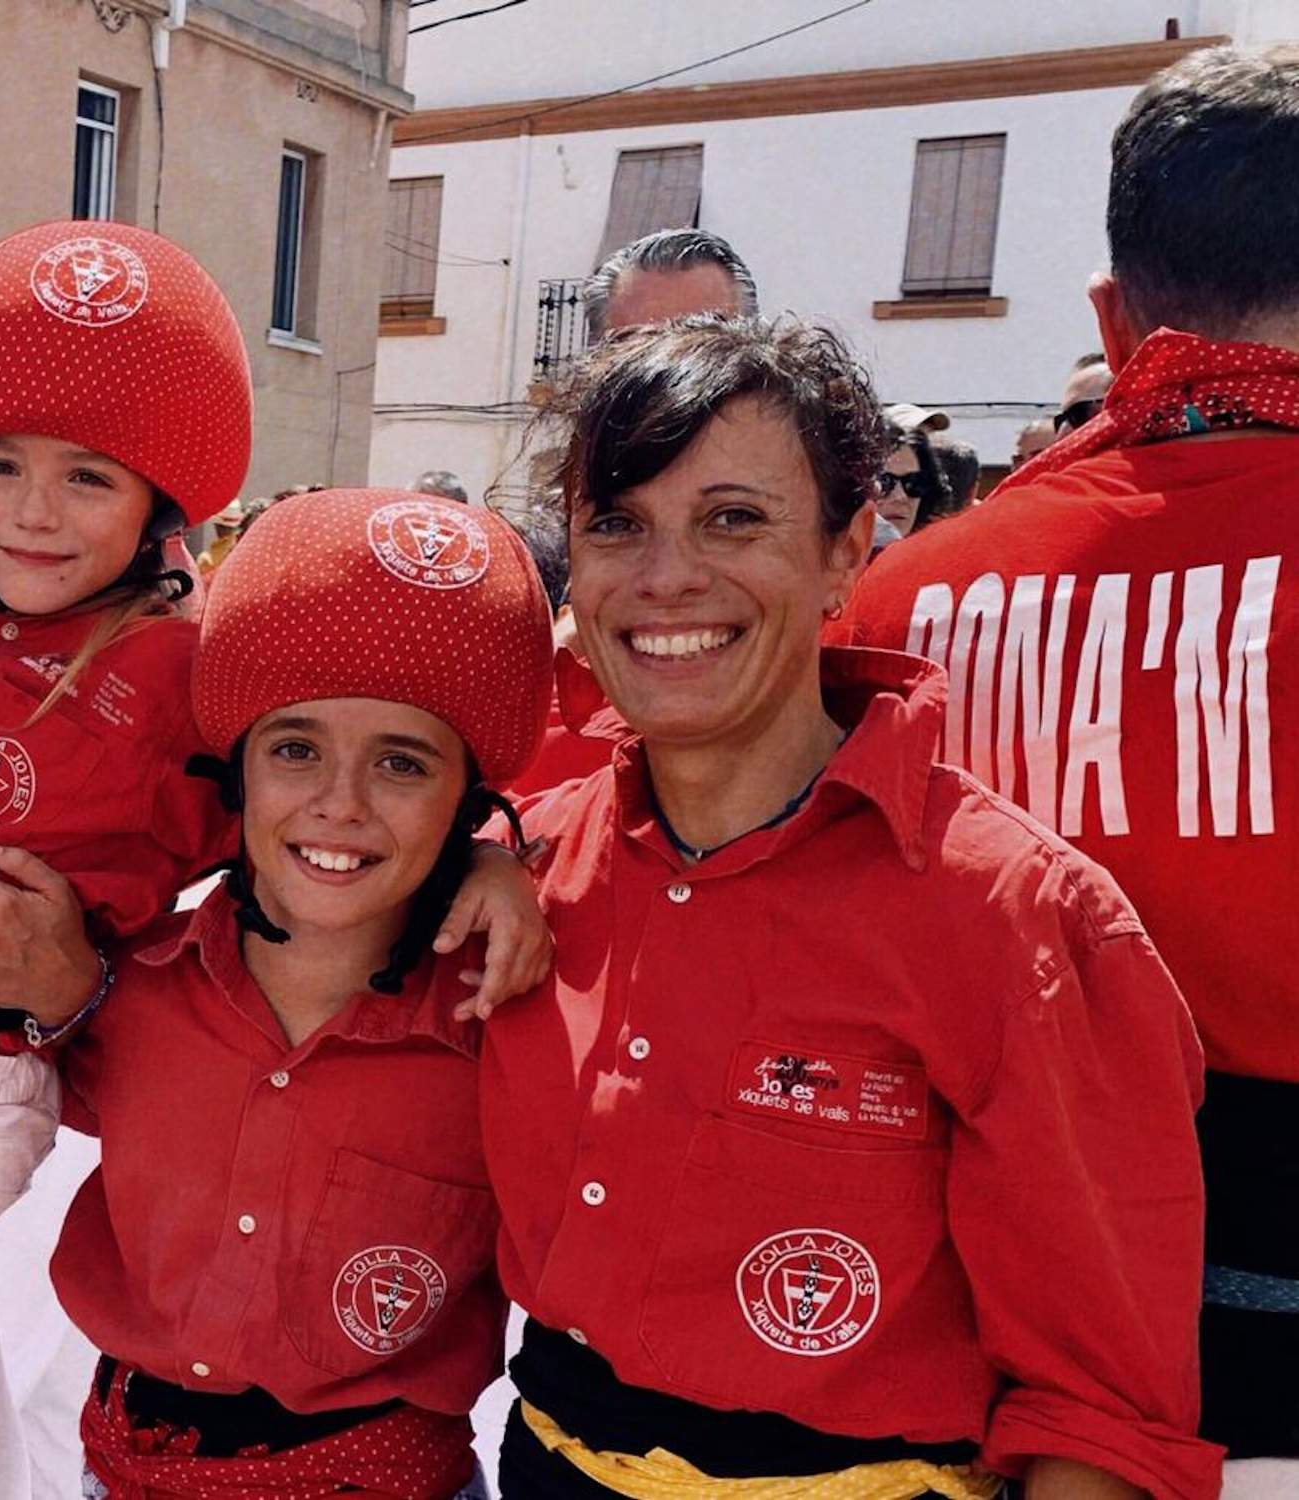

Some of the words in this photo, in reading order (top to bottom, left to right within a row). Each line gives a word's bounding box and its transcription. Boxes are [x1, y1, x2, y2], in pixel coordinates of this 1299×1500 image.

[10, 754, 31, 812] JOVES
[738, 1088, 790, 1110] xiquets
[793, 1100, 814, 1115] de
[818, 1103, 851, 1123] valls
[343, 1250, 402, 1284] COLLA
[748, 1235, 818, 1276] COLLA
[824, 1239, 876, 1297] JOVES
[340, 1304, 375, 1346] Xiquets
[750, 1298, 795, 1346] Xiquets
[799, 1336, 822, 1350] de
[822, 1319, 862, 1346] Valls
